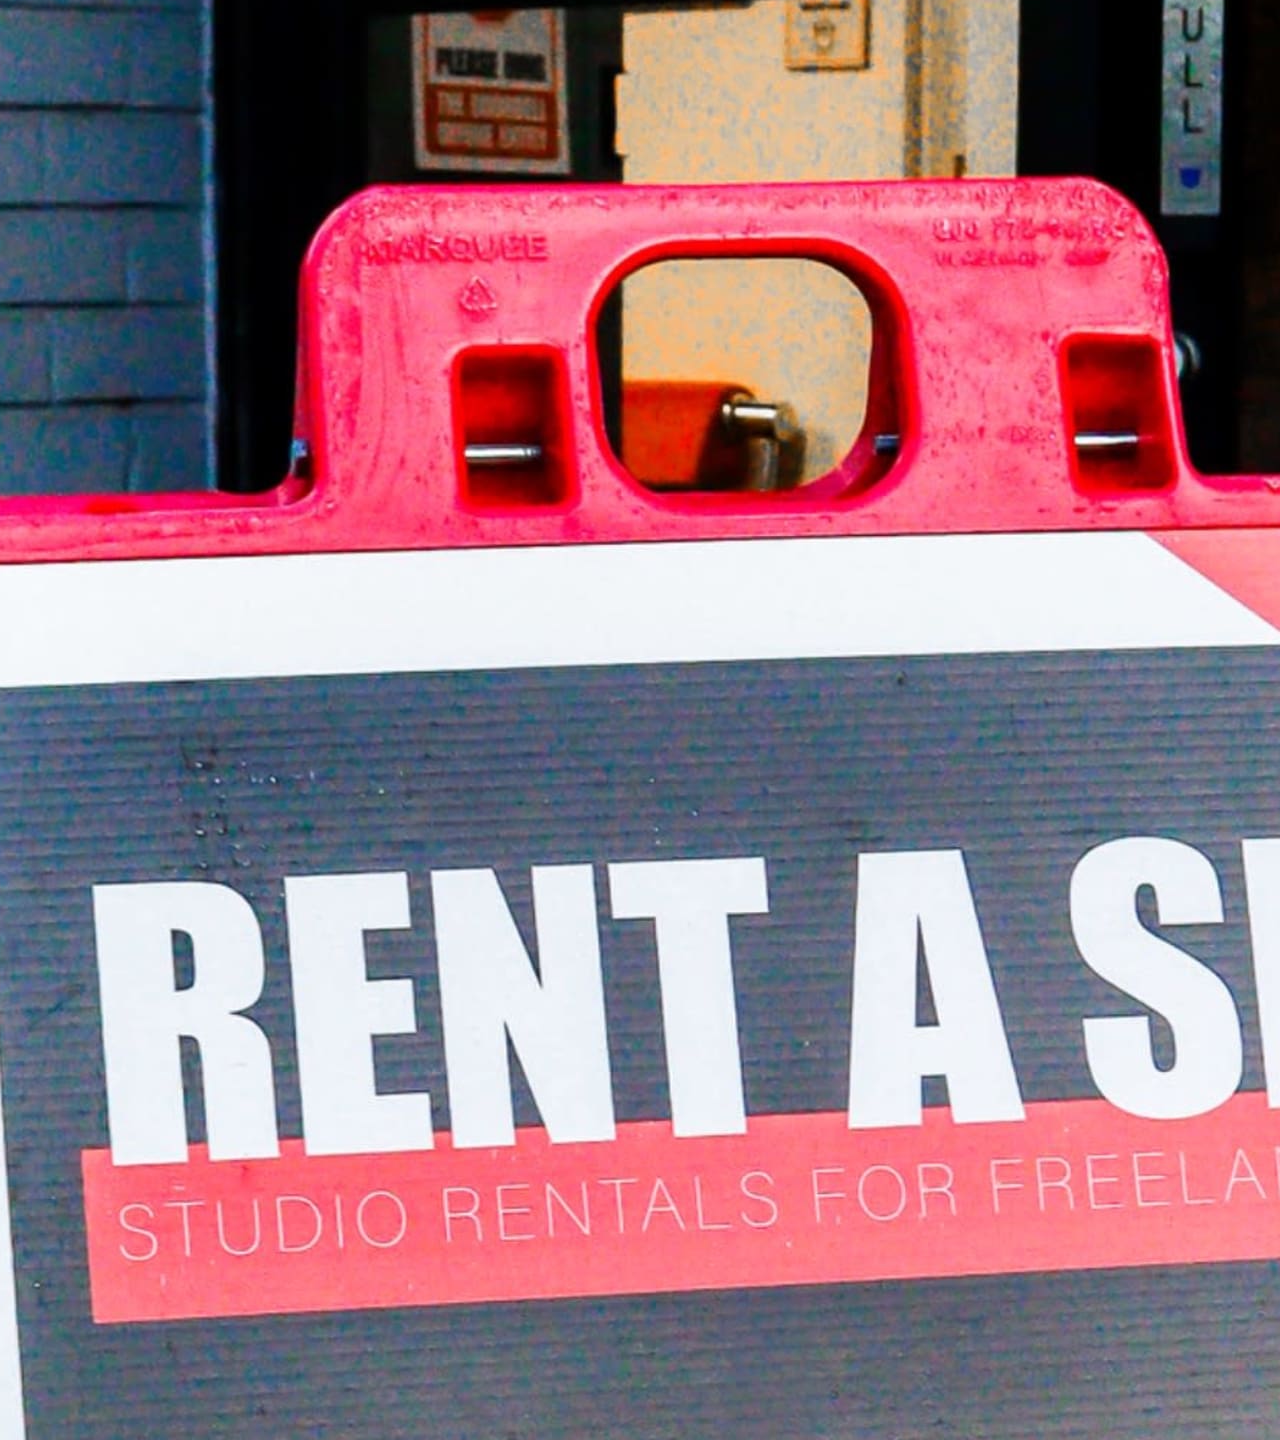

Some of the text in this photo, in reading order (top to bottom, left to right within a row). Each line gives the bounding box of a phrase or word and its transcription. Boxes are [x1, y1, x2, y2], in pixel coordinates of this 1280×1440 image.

[93, 858, 768, 1165] RENT
[849, 850, 1025, 1128] A
[118, 1189, 408, 1262] STUDIO
[442, 1171, 780, 1244] RENTALS
[811, 1162, 957, 1224] FOR
